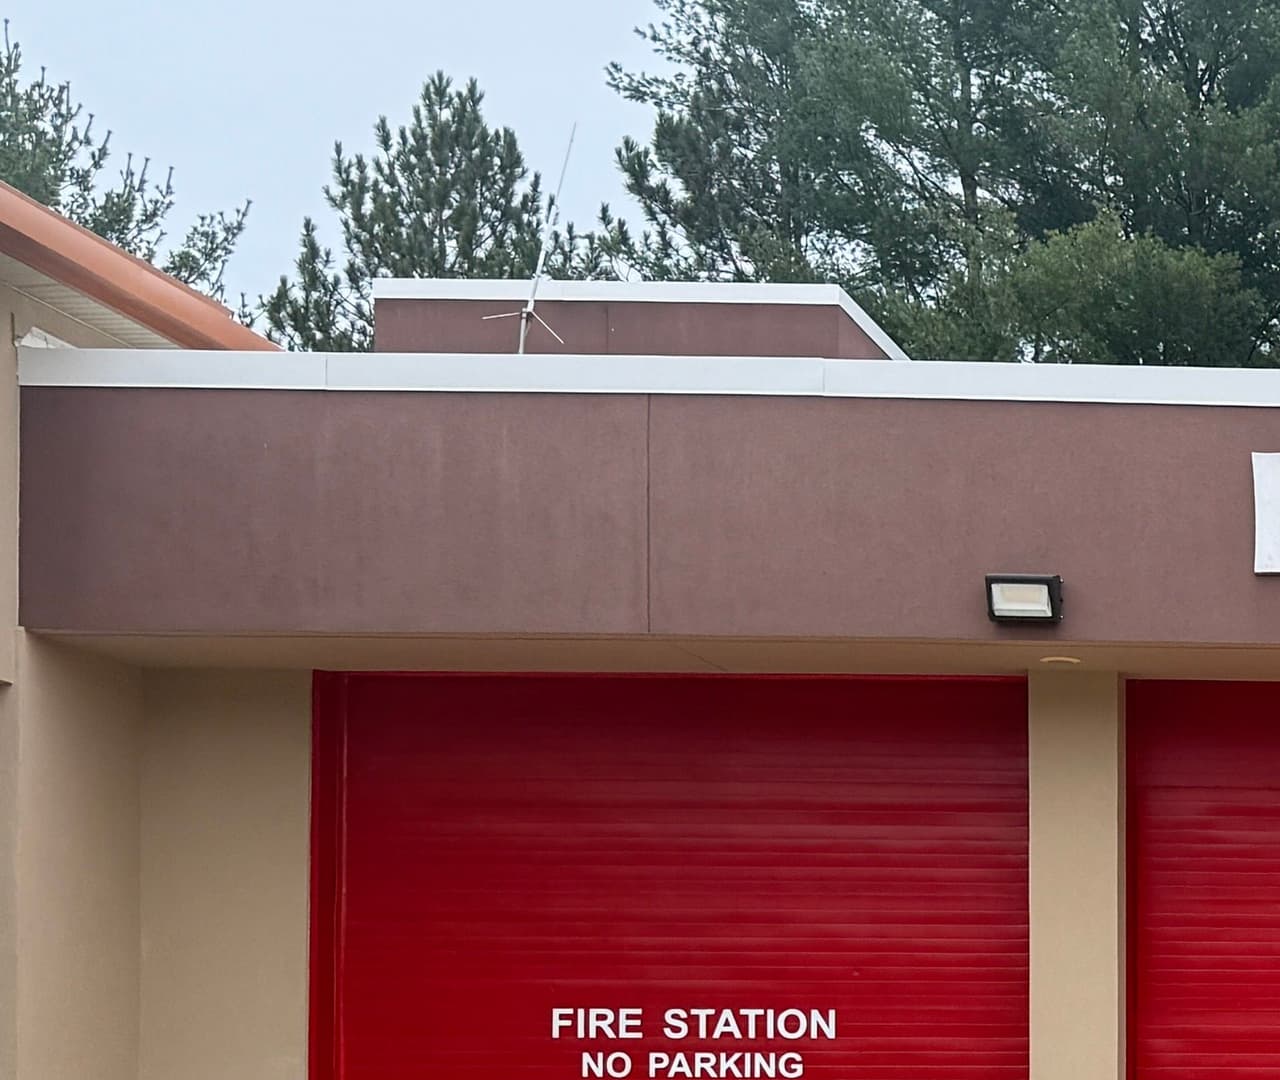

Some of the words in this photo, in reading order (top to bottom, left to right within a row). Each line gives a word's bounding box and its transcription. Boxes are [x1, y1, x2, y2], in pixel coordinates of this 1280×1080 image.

[551, 1008, 643, 1039] FIRE
[663, 1008, 836, 1040] STATION
[582, 1052, 632, 1078] NO
[648, 1052, 804, 1079] PARKING
